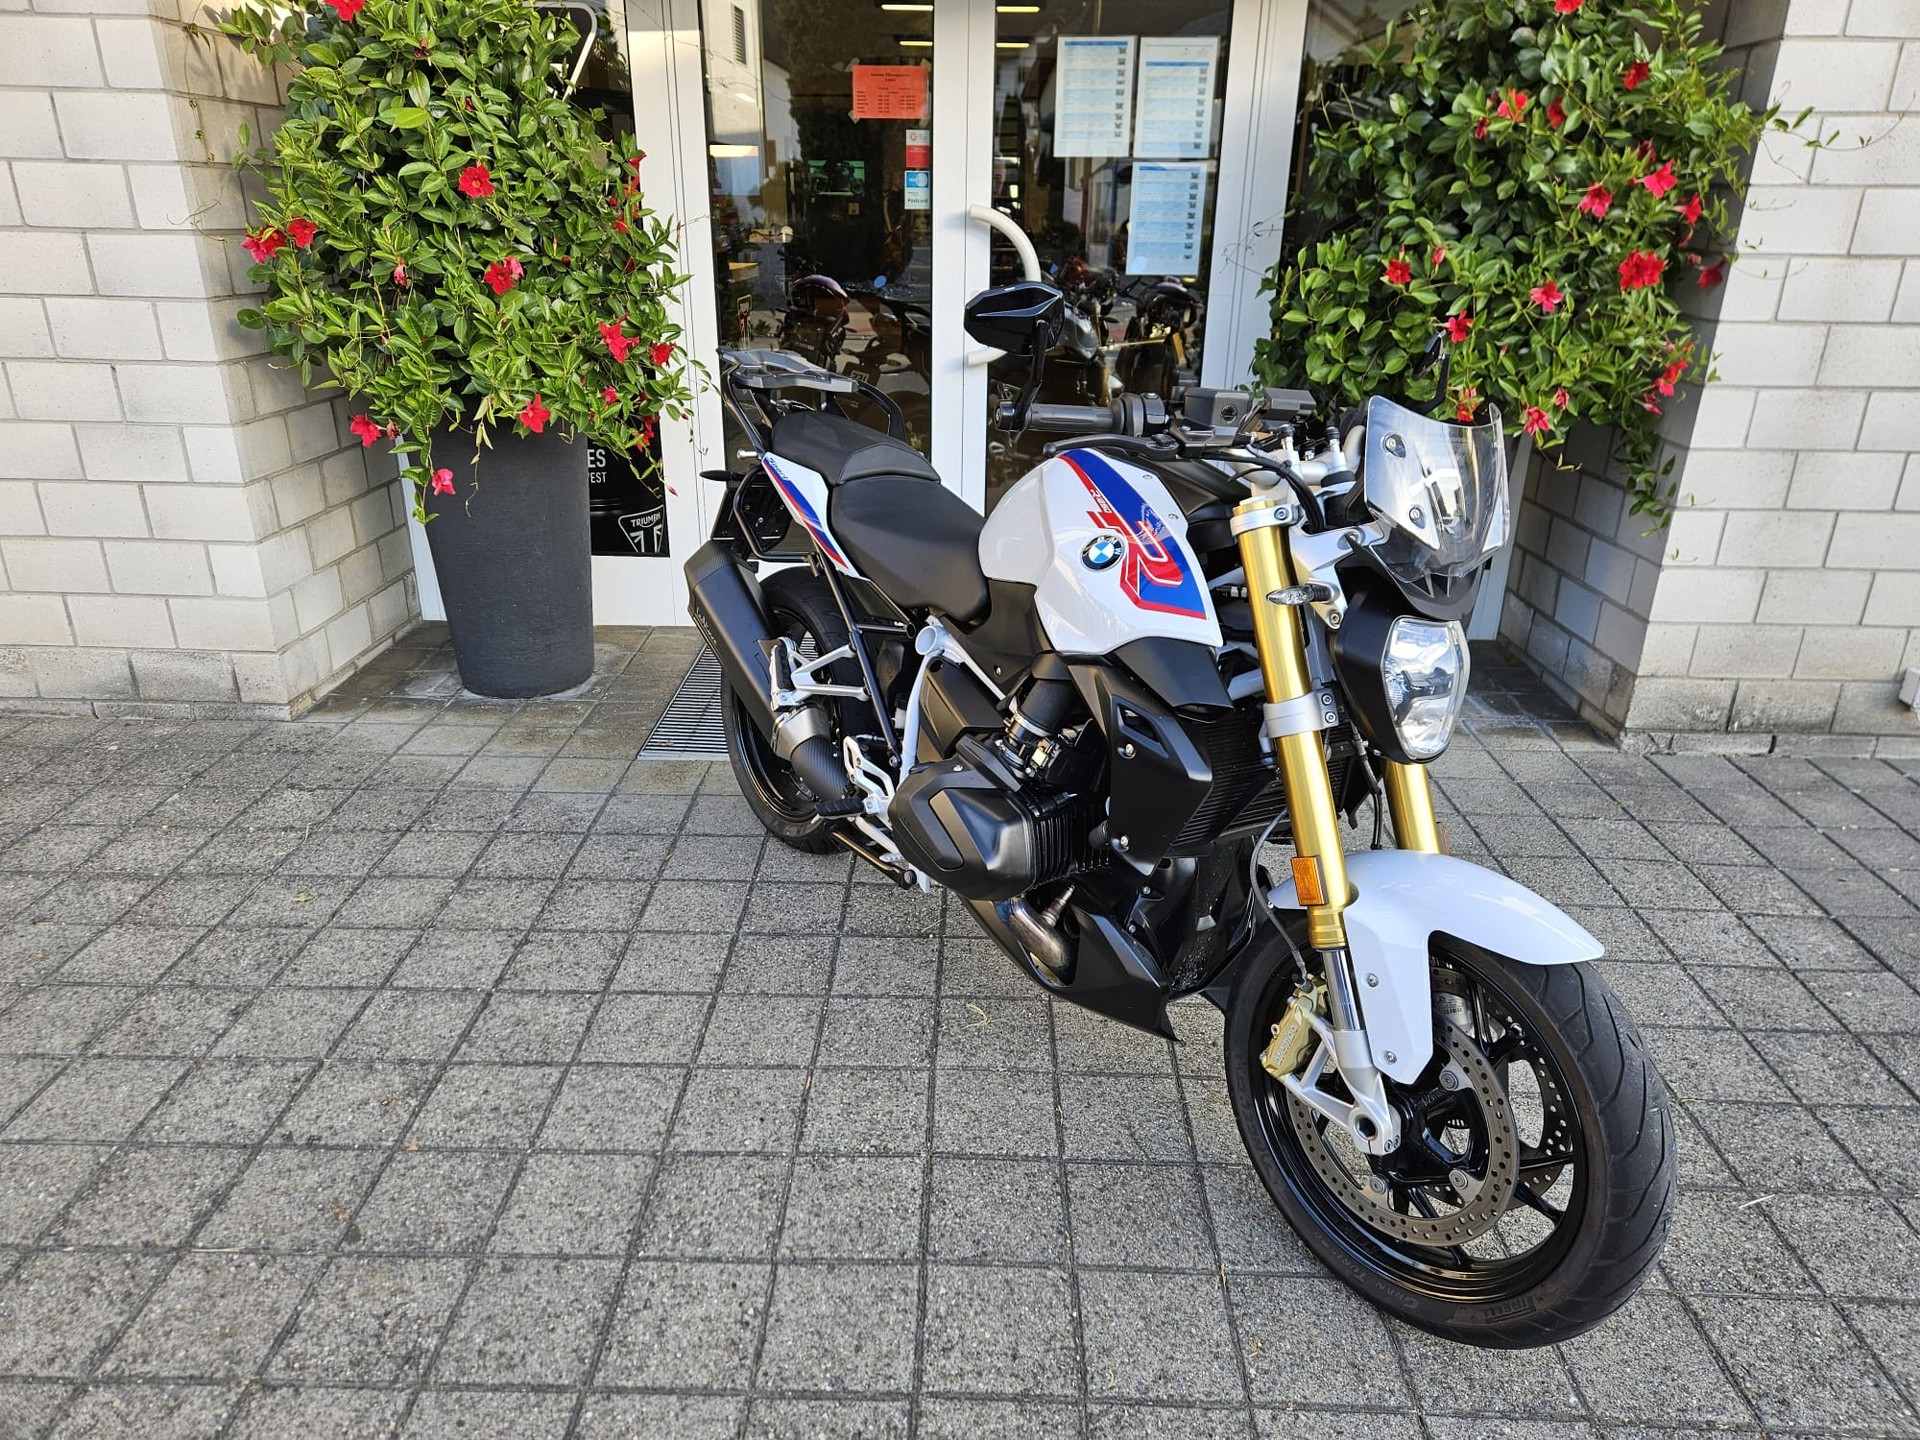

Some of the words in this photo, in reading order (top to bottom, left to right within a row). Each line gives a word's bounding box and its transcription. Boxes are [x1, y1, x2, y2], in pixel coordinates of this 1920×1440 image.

[587, 448, 606, 468] ES
[588, 471, 607, 484] EST
[630, 511, 661, 528] TRIUMPH
[1273, 1023, 1299, 1066] brembo
